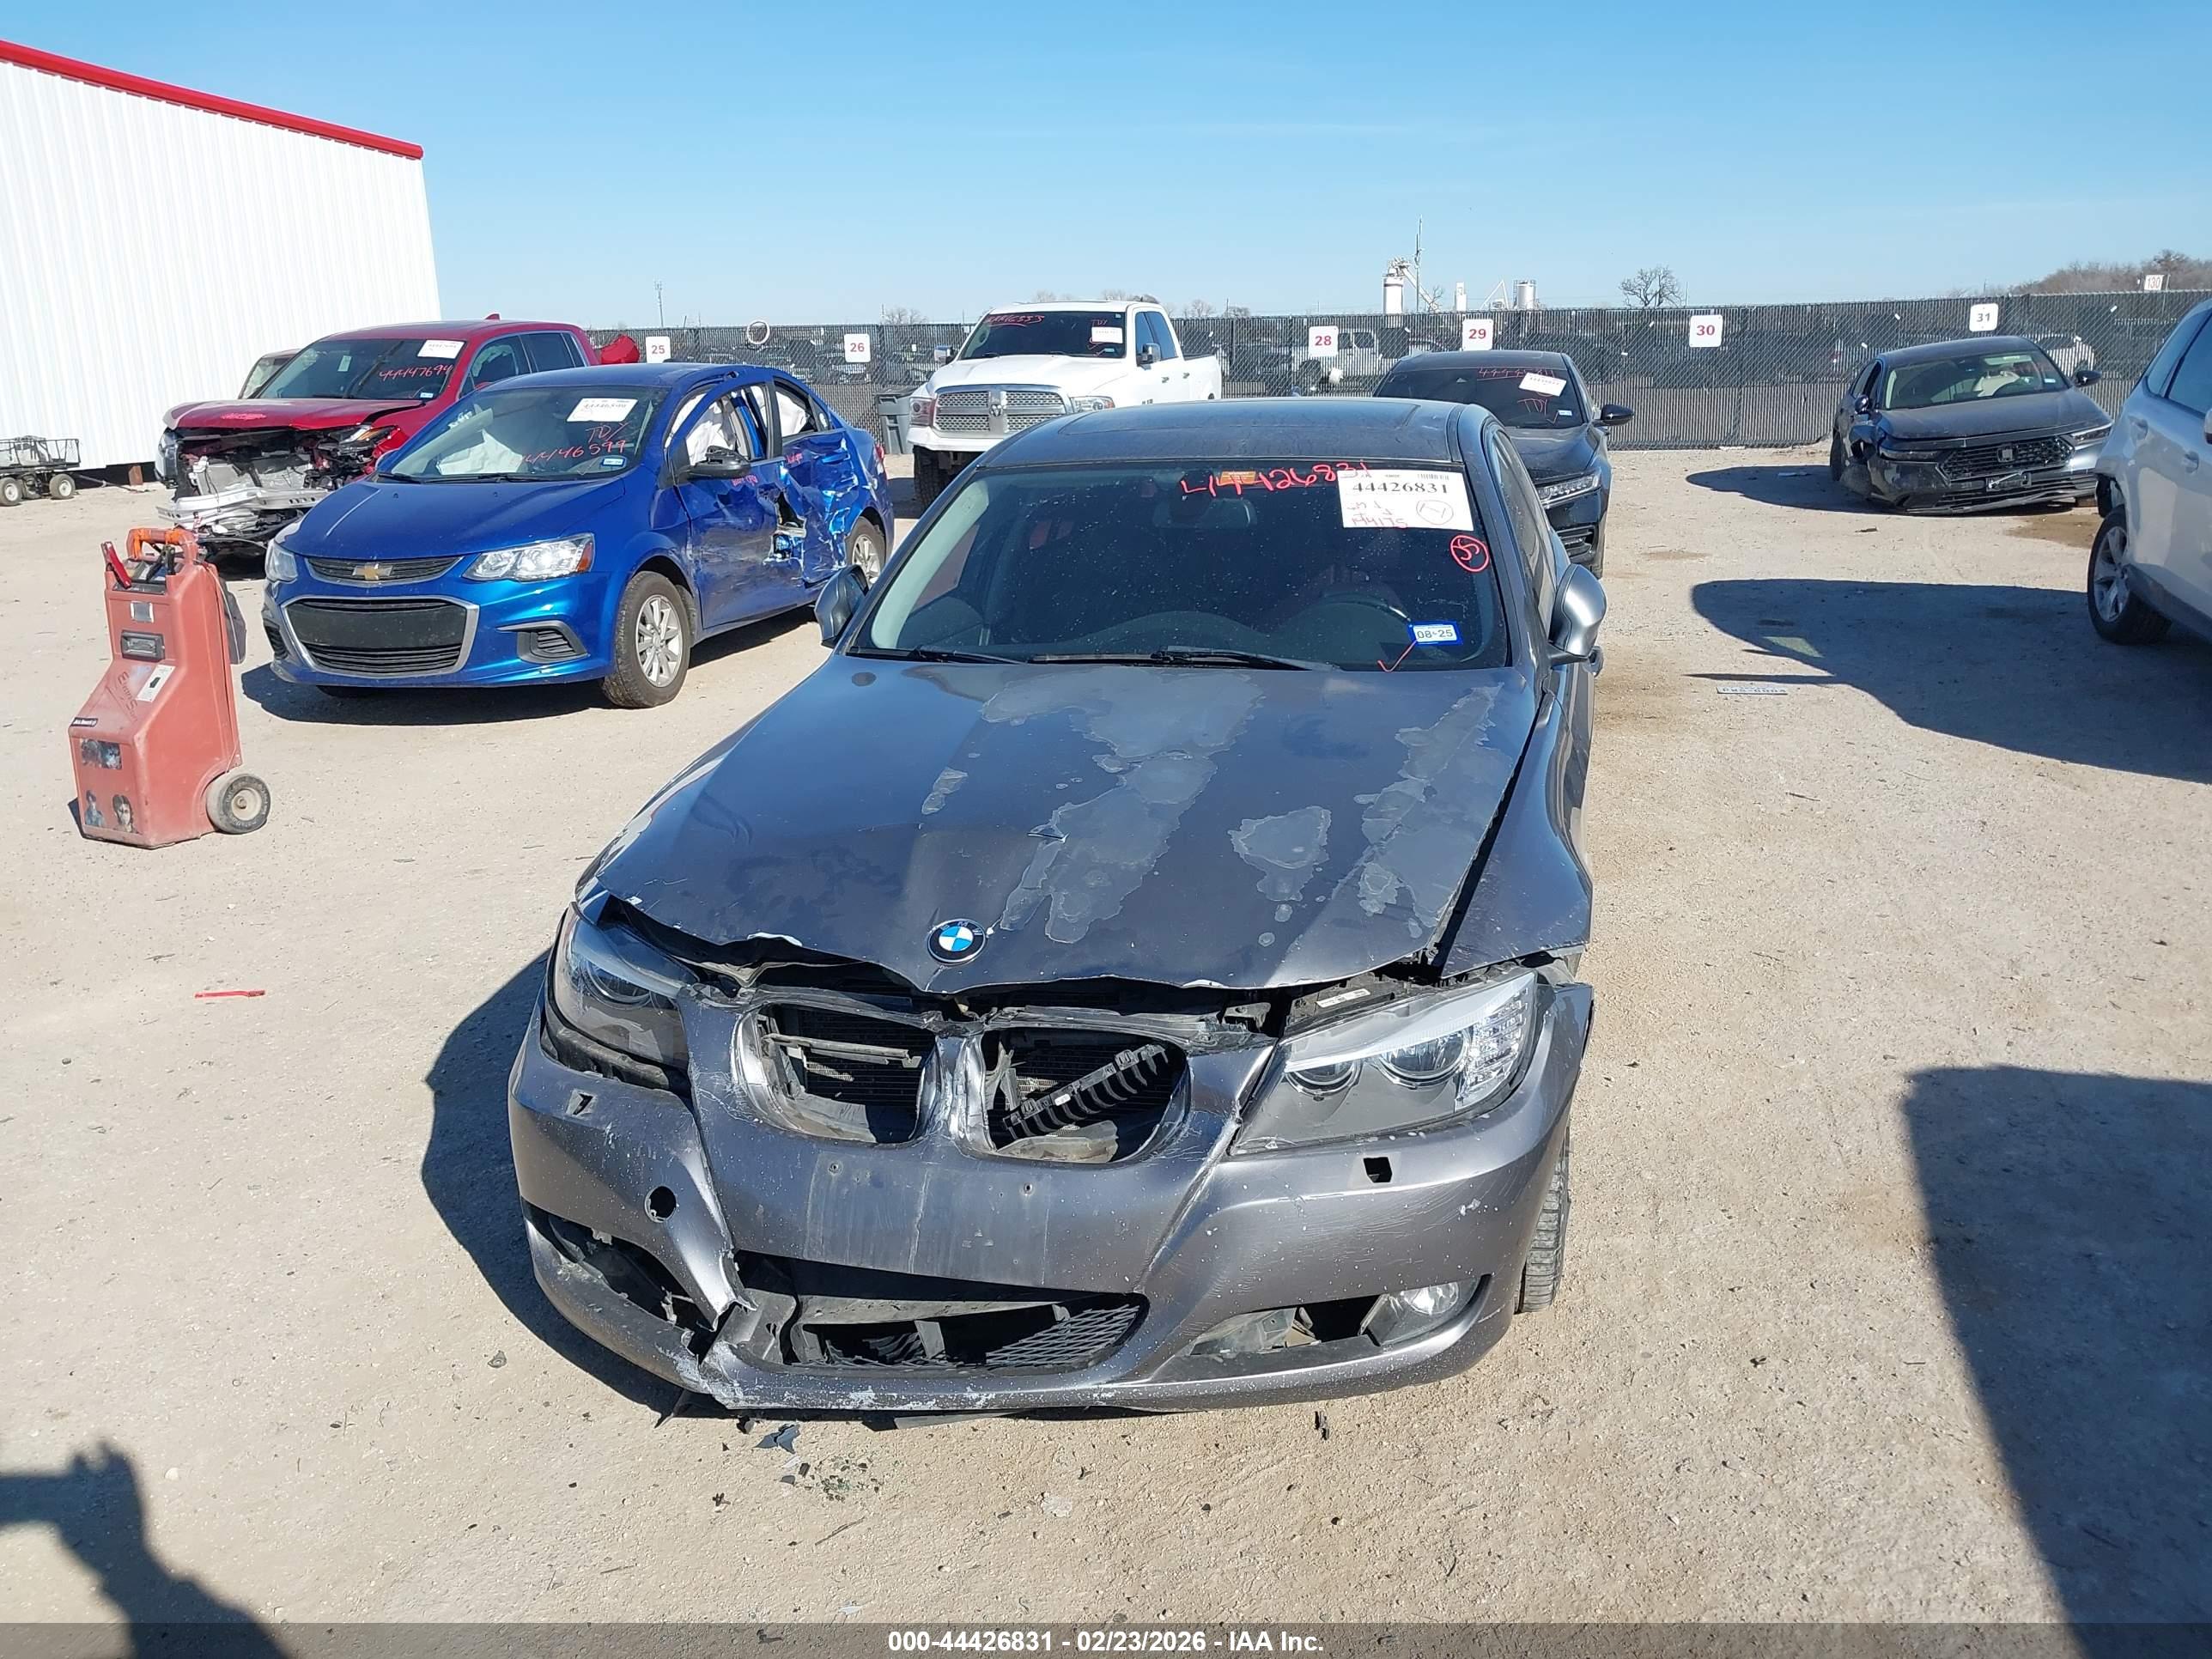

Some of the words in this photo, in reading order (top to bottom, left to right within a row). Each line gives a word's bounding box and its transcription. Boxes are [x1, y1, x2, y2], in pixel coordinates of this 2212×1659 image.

[2146, 276, 2161, 290] 130
[1976, 313, 1990, 323] 31
[1468, 328, 1486, 340] 29
[1695, 325, 1715, 337] 30
[1314, 335, 1332, 347] 28
[651, 345, 665, 356] 25
[849, 342, 865, 353] 26
[1516, 398, 1548, 416] TDY
[585, 421, 632, 444] TDY
[1352, 482, 1448, 494] 44426831
[1417, 629, 1454, 639] 08-25
